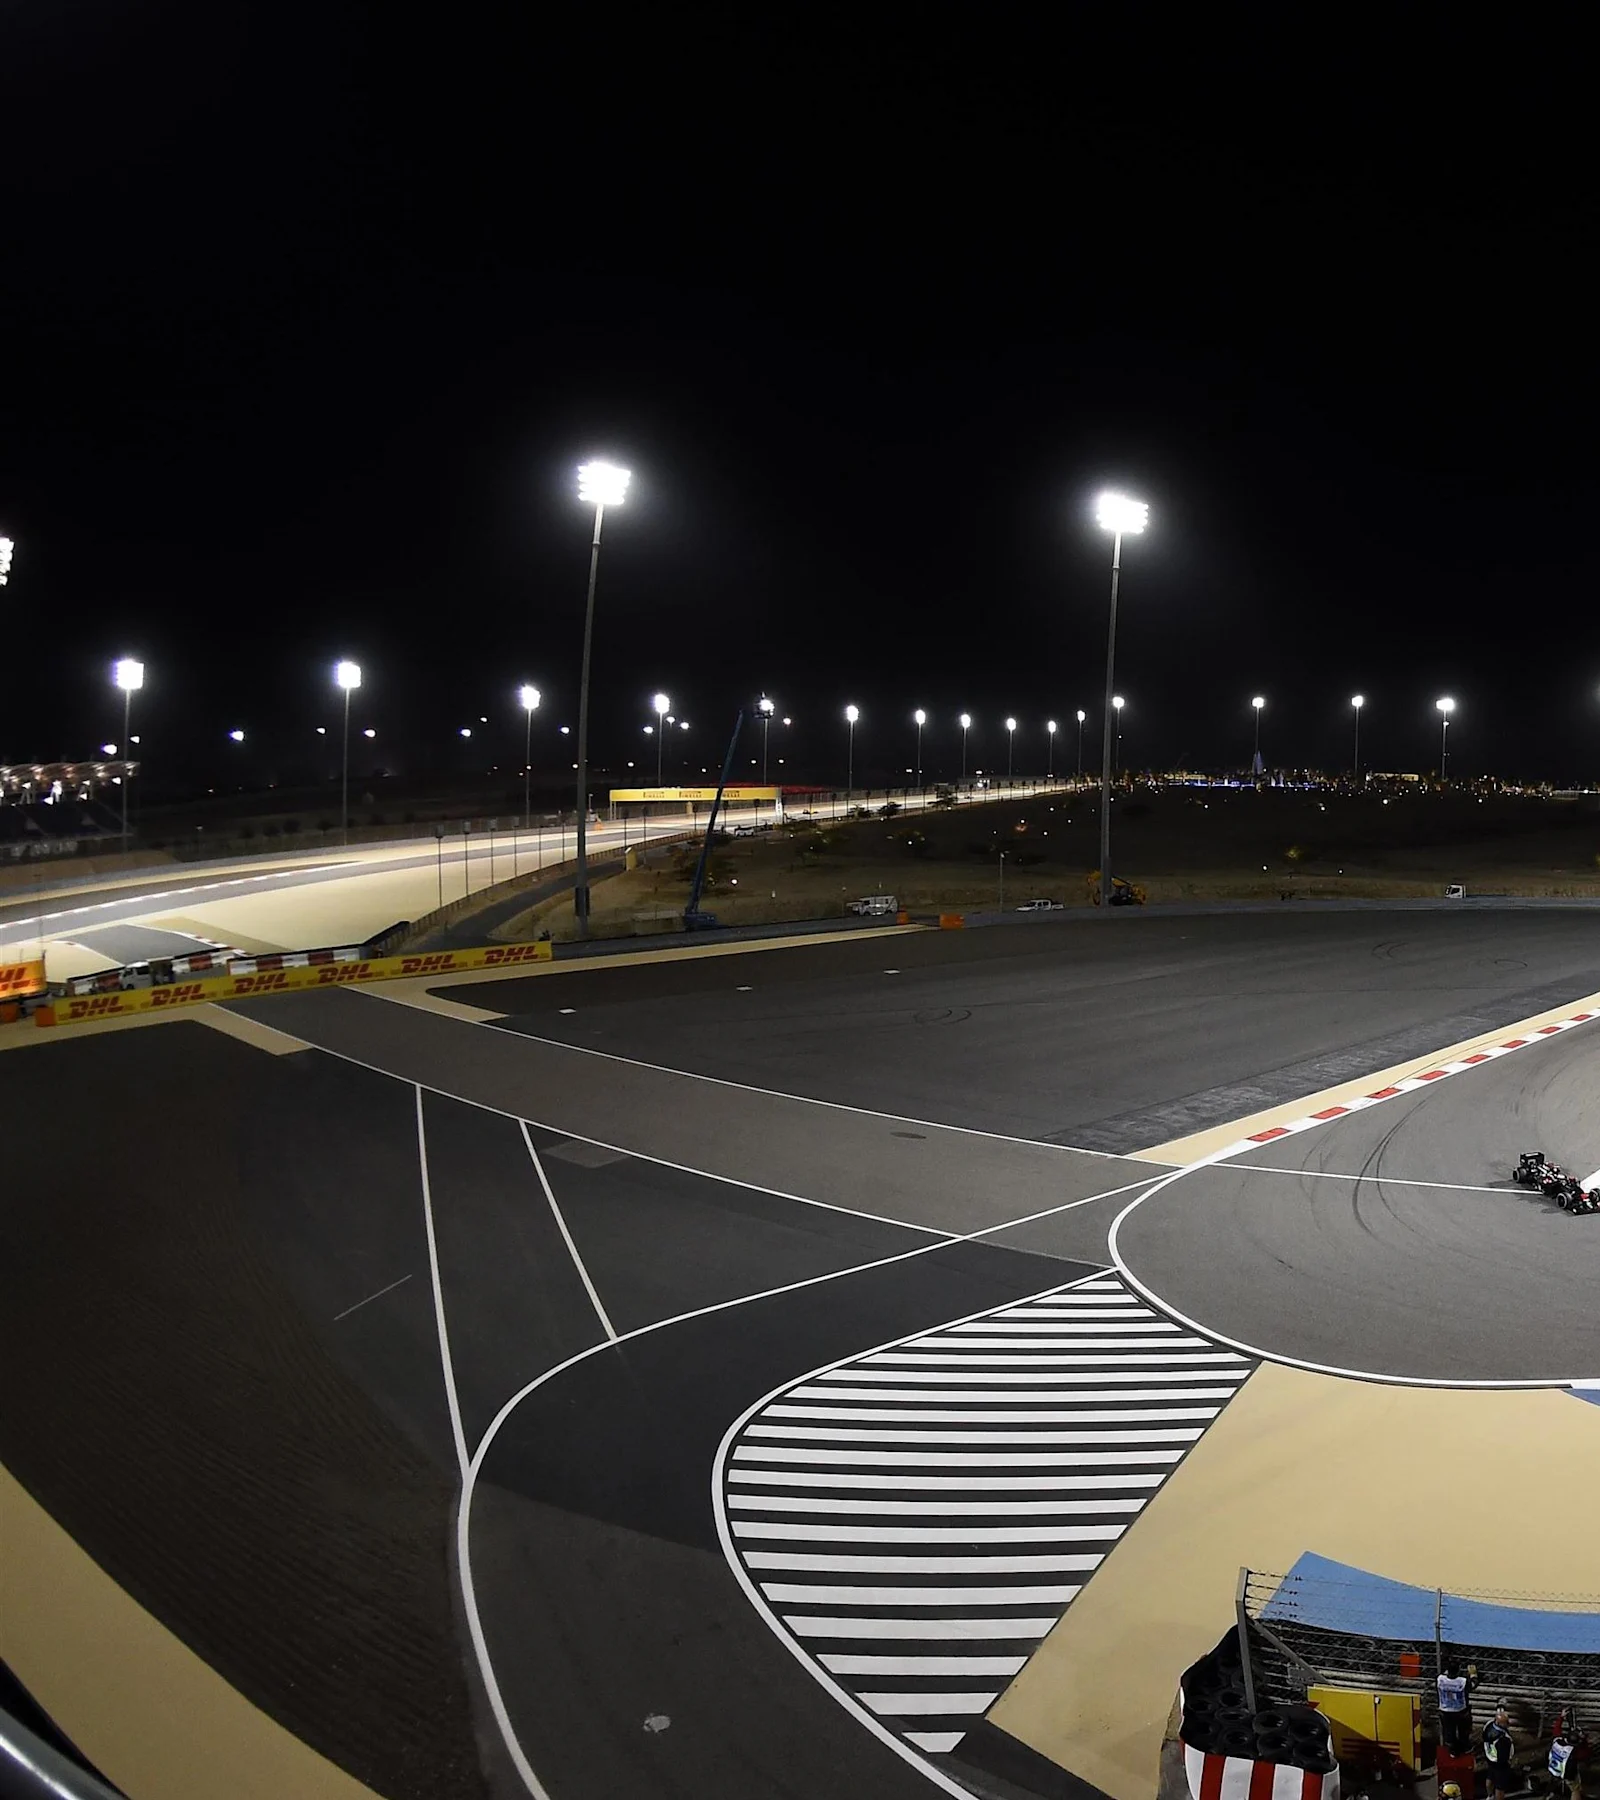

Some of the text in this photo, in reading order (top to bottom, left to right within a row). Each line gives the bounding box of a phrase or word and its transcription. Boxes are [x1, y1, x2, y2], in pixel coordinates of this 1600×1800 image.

[0, 967, 31, 991] HL
[69, 946, 539, 1019] DHL DHL DHL DHL DHL DHL
